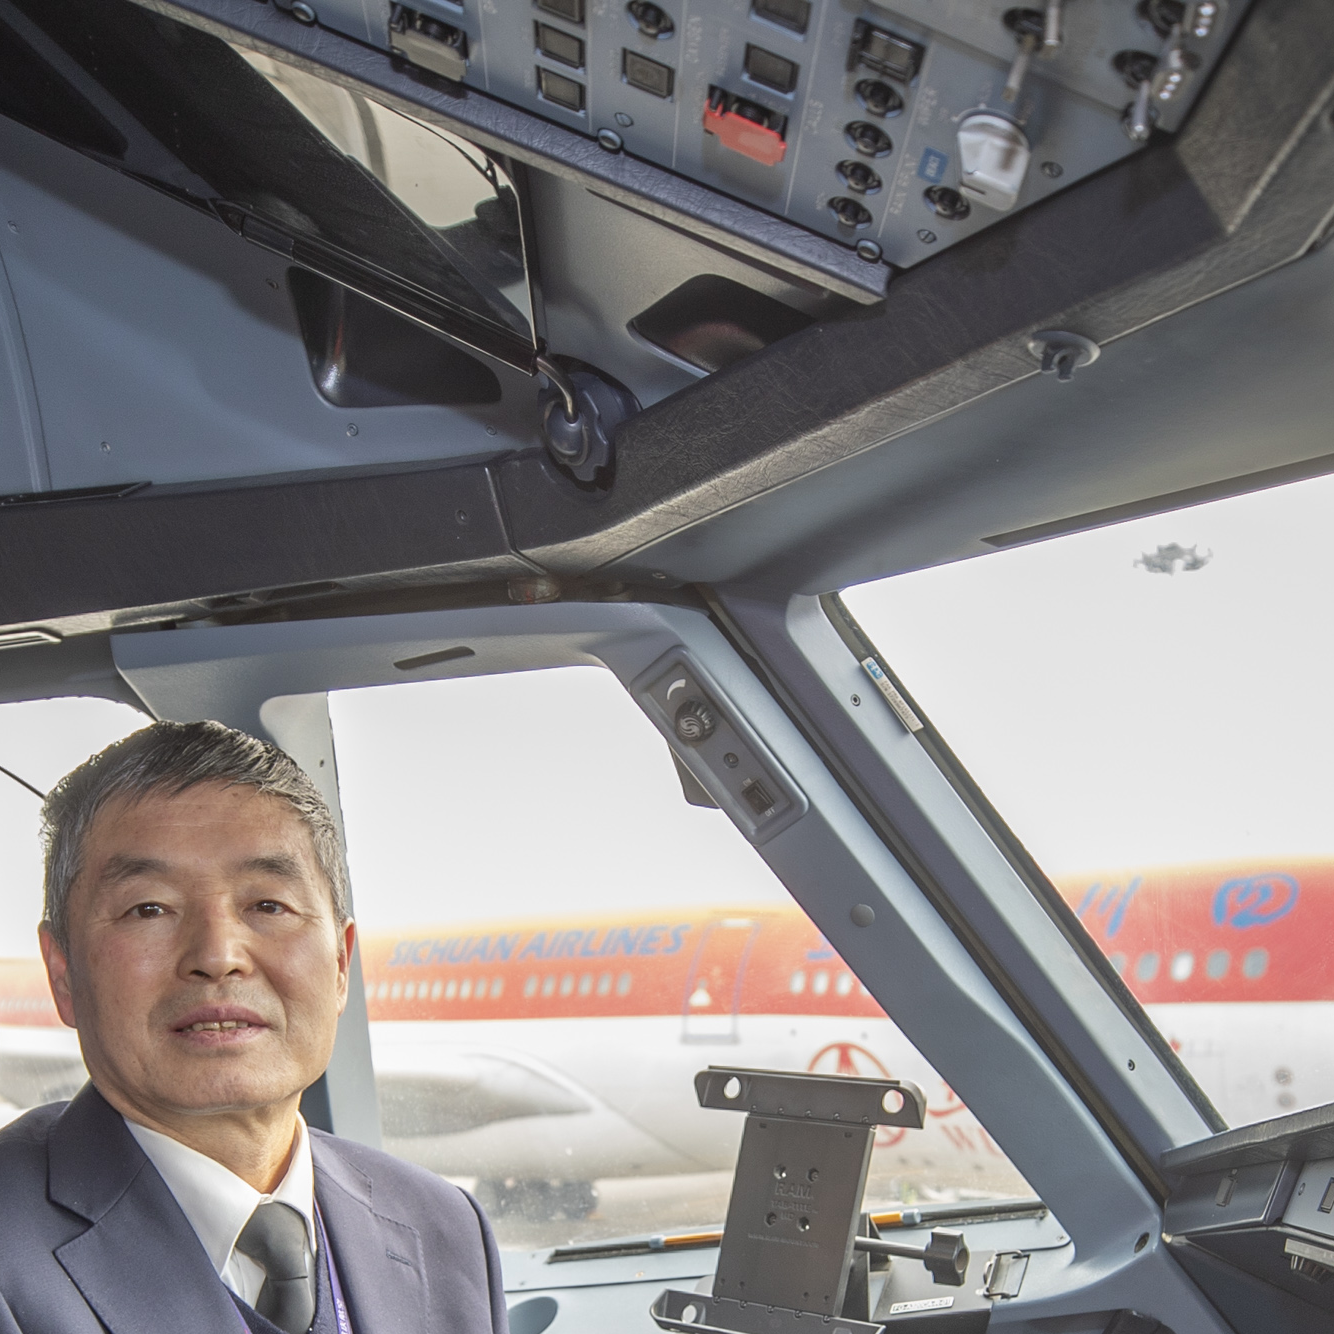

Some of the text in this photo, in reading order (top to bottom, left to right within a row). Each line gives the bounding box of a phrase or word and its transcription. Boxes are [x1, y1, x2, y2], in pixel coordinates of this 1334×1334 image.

[764, 807, 776, 818] OFF
[388, 923, 692, 968] SICHUAN AIRLINES
